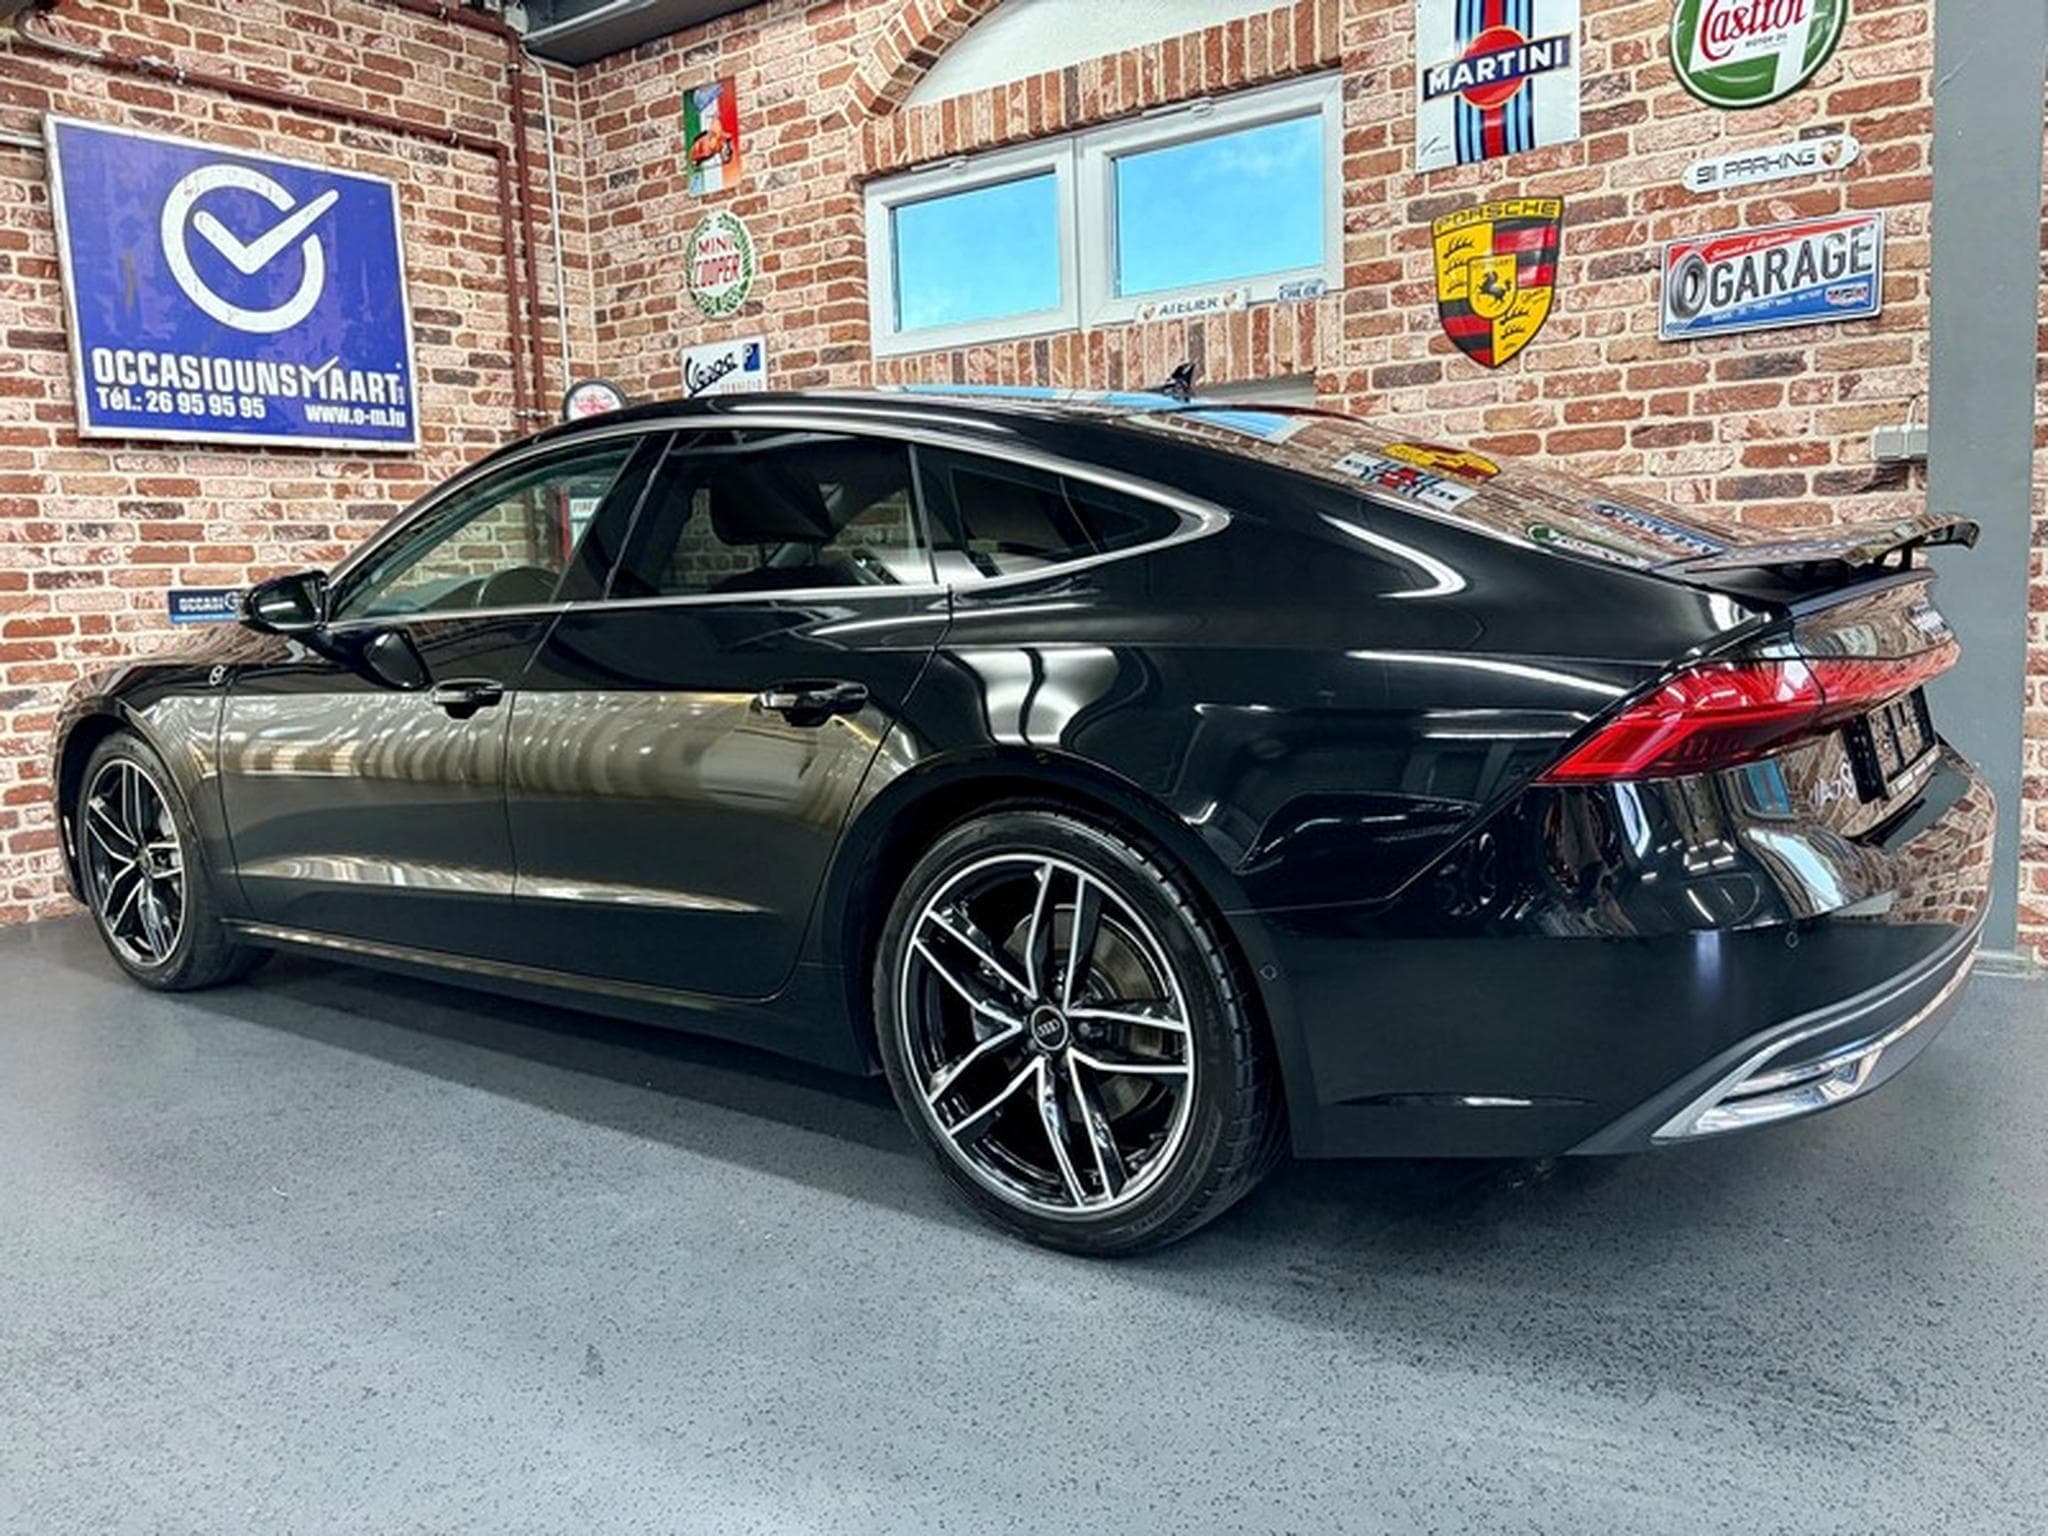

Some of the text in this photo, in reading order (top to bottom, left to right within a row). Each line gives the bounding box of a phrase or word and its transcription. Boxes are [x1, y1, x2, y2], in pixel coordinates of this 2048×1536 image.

[1427, 40, 1563, 95] MARTINI
[1723, 148, 1816, 179] PARKING
[1435, 201, 1557, 232] PORSCHE
[698, 236, 733, 256] MINI
[695, 254, 740, 288] COOPER
[1709, 224, 1874, 309] GARAGE
[1159, 296, 1219, 316] ATELIER
[96, 386, 266, 420] Tél.: 26 95 95 95
[304, 403, 406, 428] www.o-m.lu
